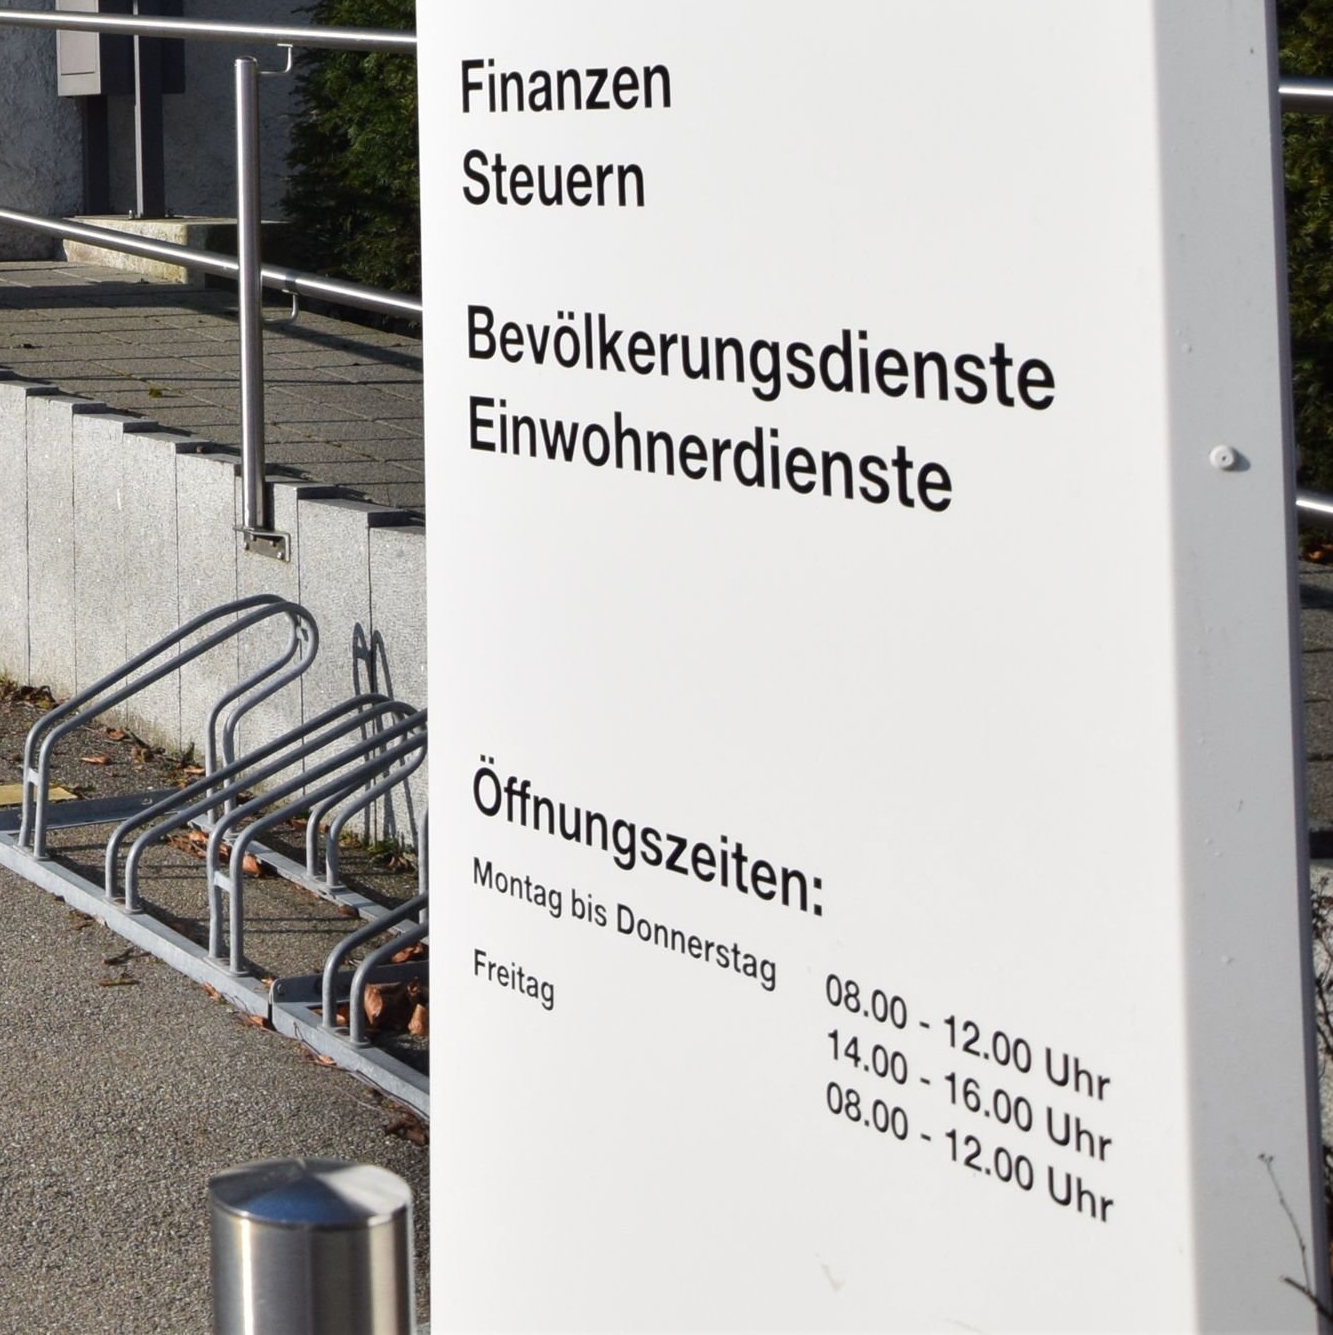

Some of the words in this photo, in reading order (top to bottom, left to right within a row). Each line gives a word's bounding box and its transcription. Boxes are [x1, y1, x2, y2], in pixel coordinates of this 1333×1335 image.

[461, 58, 671, 114] Finanzen
[462, 148, 645, 207] Steuern
[467, 304, 1056, 411] Bevölkerungsdienste
[469, 395, 953, 513] Einwohnerdienste
[473, 755, 823, 917] Öffnungszeiten:
[473, 857, 562, 919] Montag
[571, 888, 607, 927] bis
[617, 903, 776, 992] Donnerstag
[473, 948, 555, 1011] Freitag
[825, 973, 908, 1030] 08.00
[944, 1015, 1032, 1074] 12.00
[1045, 1047, 1111, 1101] Uhr
[827, 1029, 908, 1085] 14.00
[944, 1072, 1033, 1133] 16.00
[1046, 1106, 1112, 1162] Uhr
[825, 1081, 909, 1141] 08.00
[945, 1128, 1034, 1192] 12.00
[1047, 1166, 1114, 1223] Uhr
